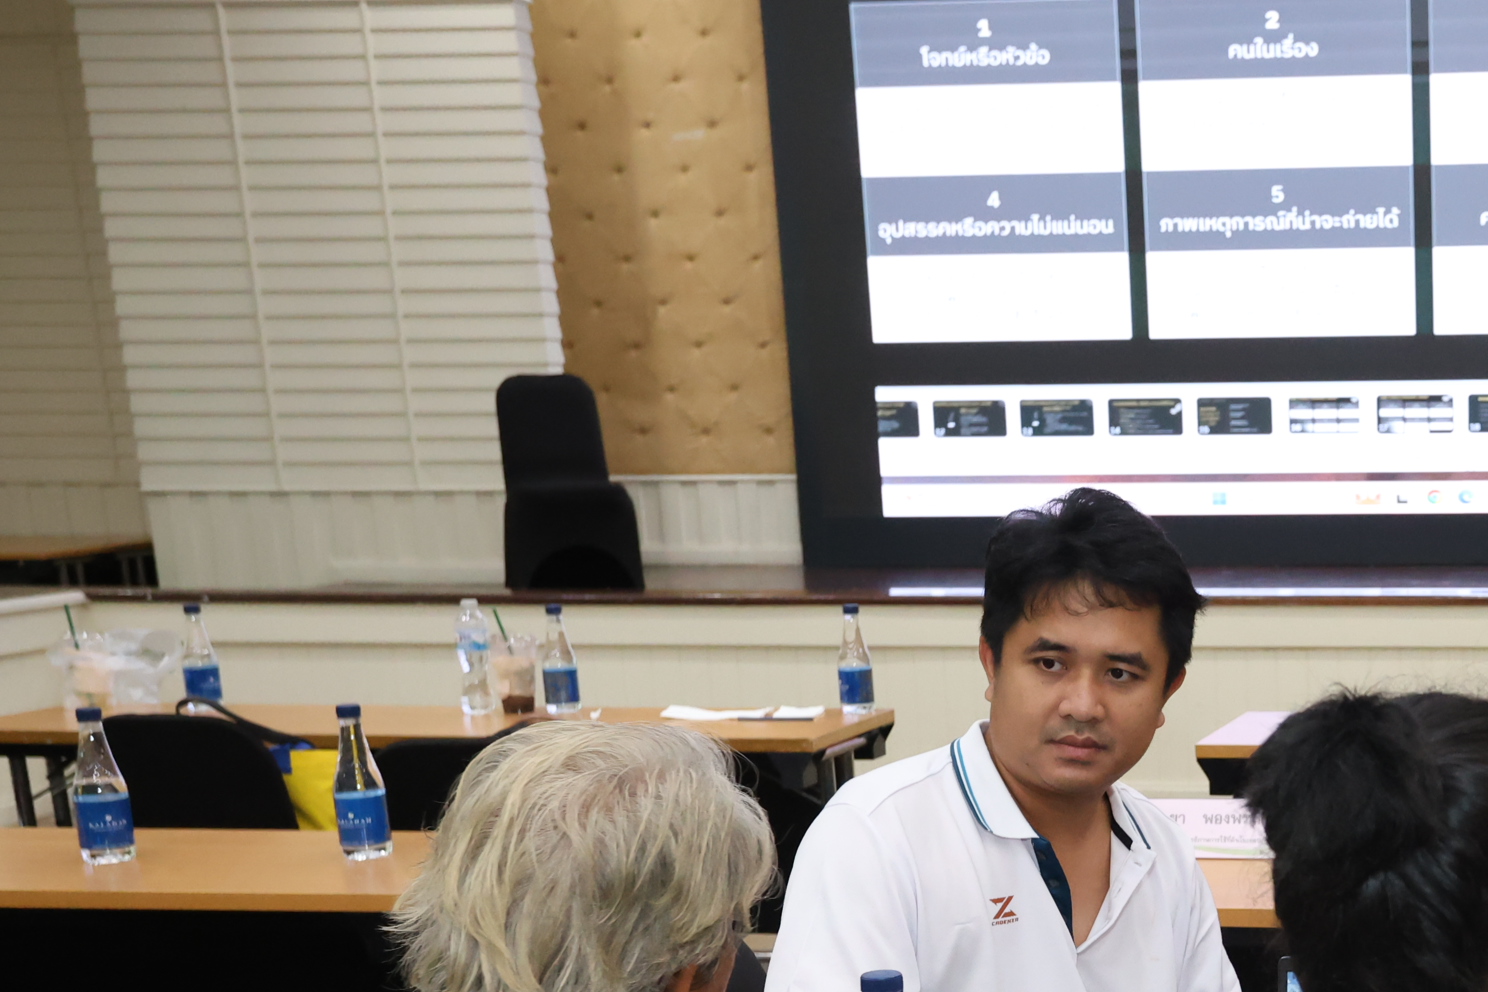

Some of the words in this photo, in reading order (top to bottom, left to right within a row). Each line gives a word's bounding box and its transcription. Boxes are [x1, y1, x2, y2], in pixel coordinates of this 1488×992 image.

[976, 18, 992, 38] 1
[1264, 9, 1280, 30] 2
[919, 42, 1051, 68] โจทย์หรือหัวข้อ
[1227, 32, 1319, 60] คนในเรื่อง
[986, 190, 1001, 209] 4
[1270, 184, 1285, 204] 5
[877, 213, 1115, 245] อุปสรรคหรือความไม่แน่นอน
[1159, 206, 1401, 239] ภาพเหตุการณ์ที่น่าจะถ่ายได้
